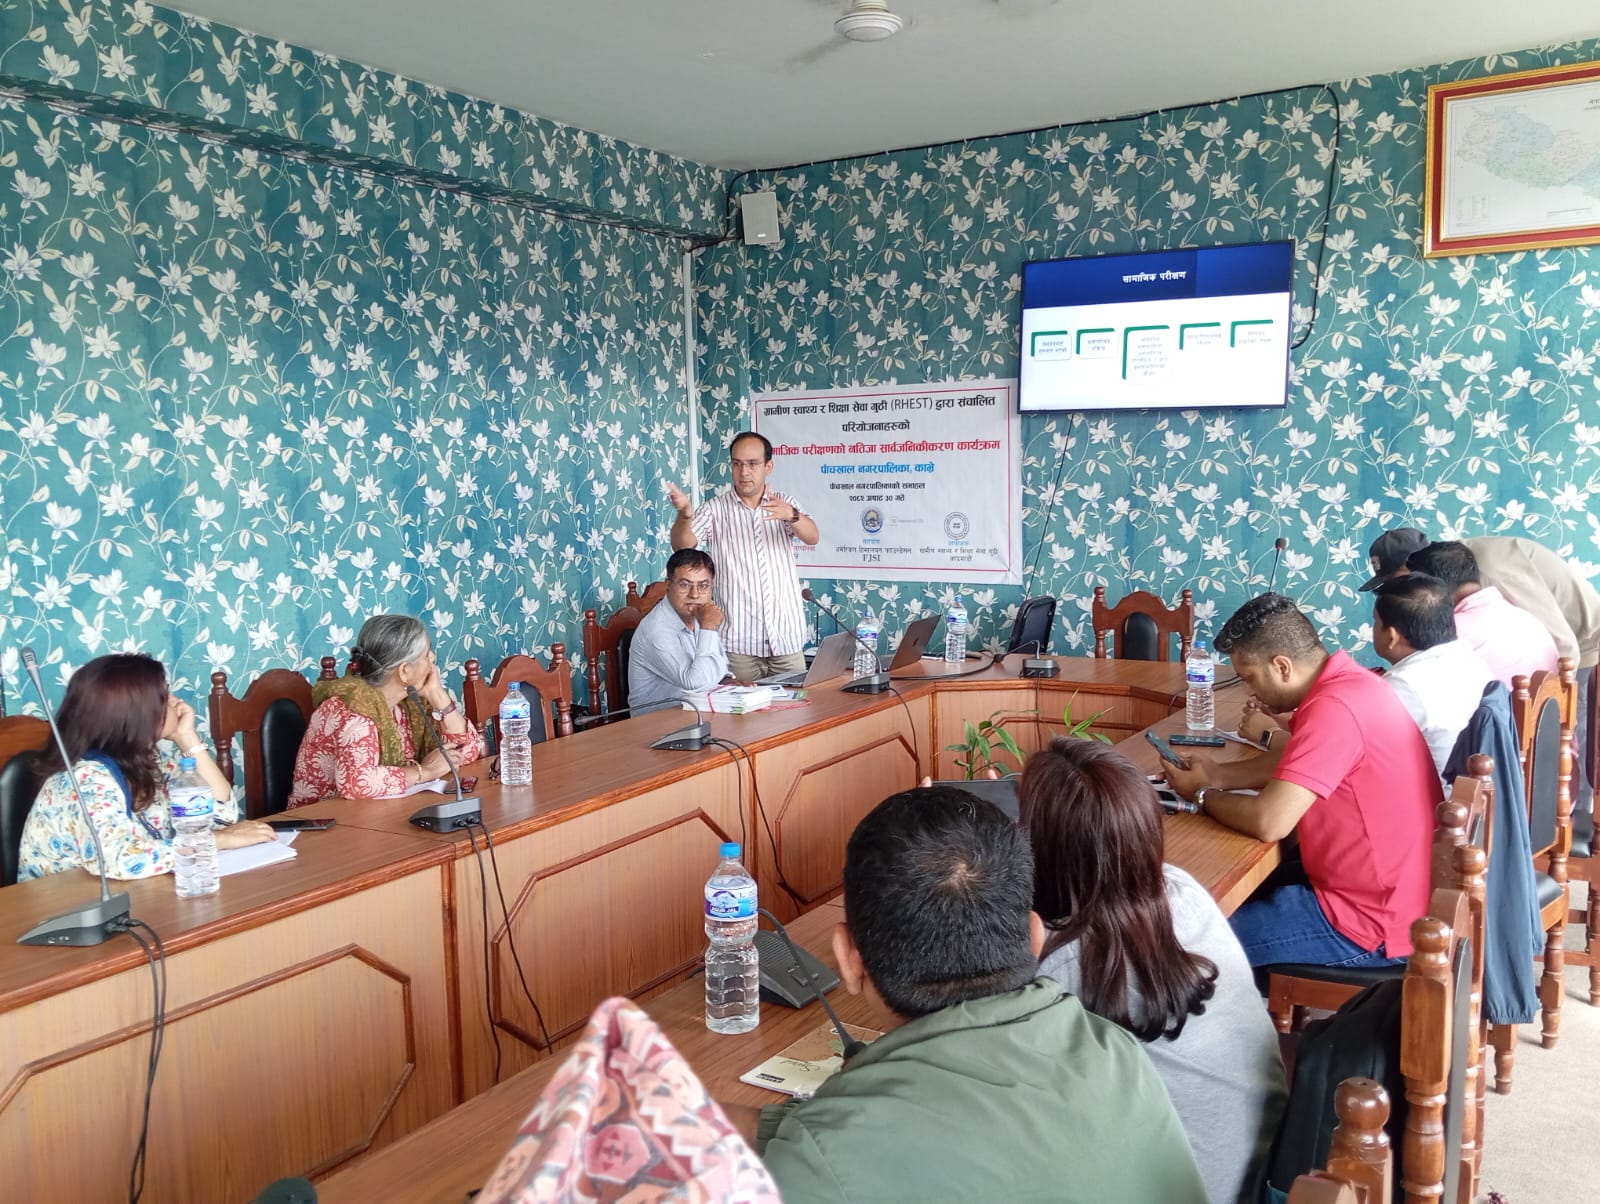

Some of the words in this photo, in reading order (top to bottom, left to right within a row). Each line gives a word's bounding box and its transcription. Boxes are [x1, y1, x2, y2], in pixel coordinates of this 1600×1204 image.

[1122, 272, 1157, 283] सामाजिक
[1159, 270, 1187, 281] परीक्षण
[763, 404, 790, 416] ग्रामीण
[820, 405, 826, 414] र
[828, 402, 849, 413] शिक्षा
[852, 401, 868, 412] सेवा
[870, 400, 888, 413] गुठी
[890, 397, 933, 412] (RHEST)
[935, 398, 955, 410] द्वारा
[957, 394, 996, 407] संचालित
[802, 442, 845, 456] परीक्षणको
[848, 441, 877, 454] नतिजा
[880, 440, 954, 453] सार्वजनिकीकरण
[957, 438, 1001, 450] कार्यक्रम
